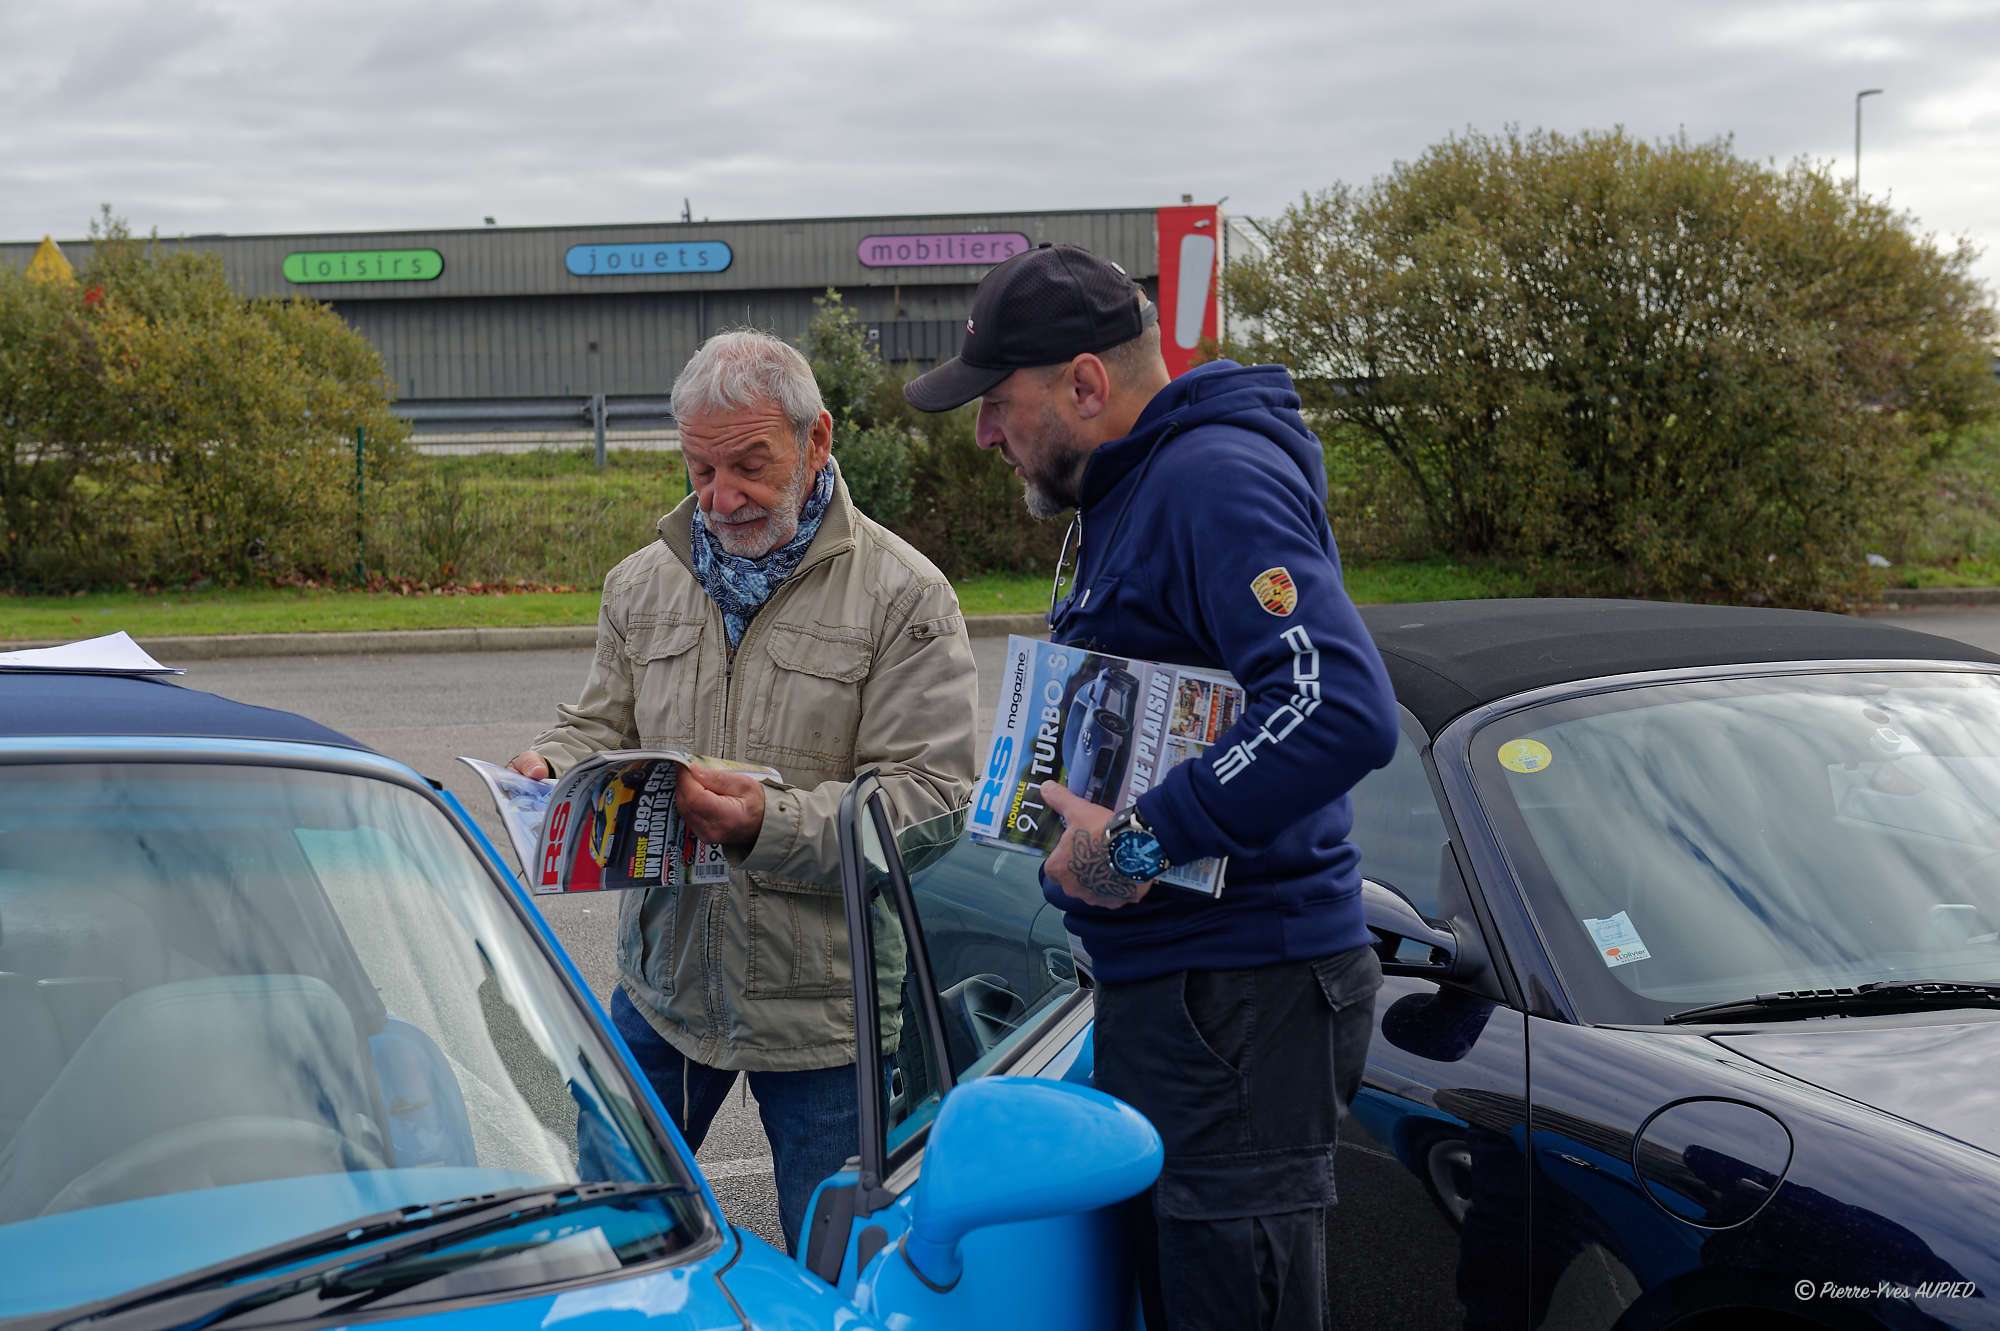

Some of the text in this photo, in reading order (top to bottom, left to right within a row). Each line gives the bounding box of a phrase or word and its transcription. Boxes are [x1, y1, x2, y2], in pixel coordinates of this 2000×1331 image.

[301, 250, 423, 276] loisirs
[588, 246, 710, 274] jouets
[871, 237, 1015, 262] mobiliers
[1031, 681, 1065, 775] TURBO
[1050, 653, 1068, 671] S
[1138, 670, 1172, 767] PLAISIR
[1212, 625, 1322, 785] PORSCHE
[974, 735, 1013, 826] RS
[1007, 652, 1026, 729] magazine
[634, 794, 655, 833] 992
[653, 791, 672, 810] DE
[1007, 779, 1027, 829] NOUVELLE
[542, 801, 571, 885] RS
[648, 811, 668, 855] AVION
[634, 836, 649, 879] EXCLUSIF
[644, 857, 662, 878] UN
